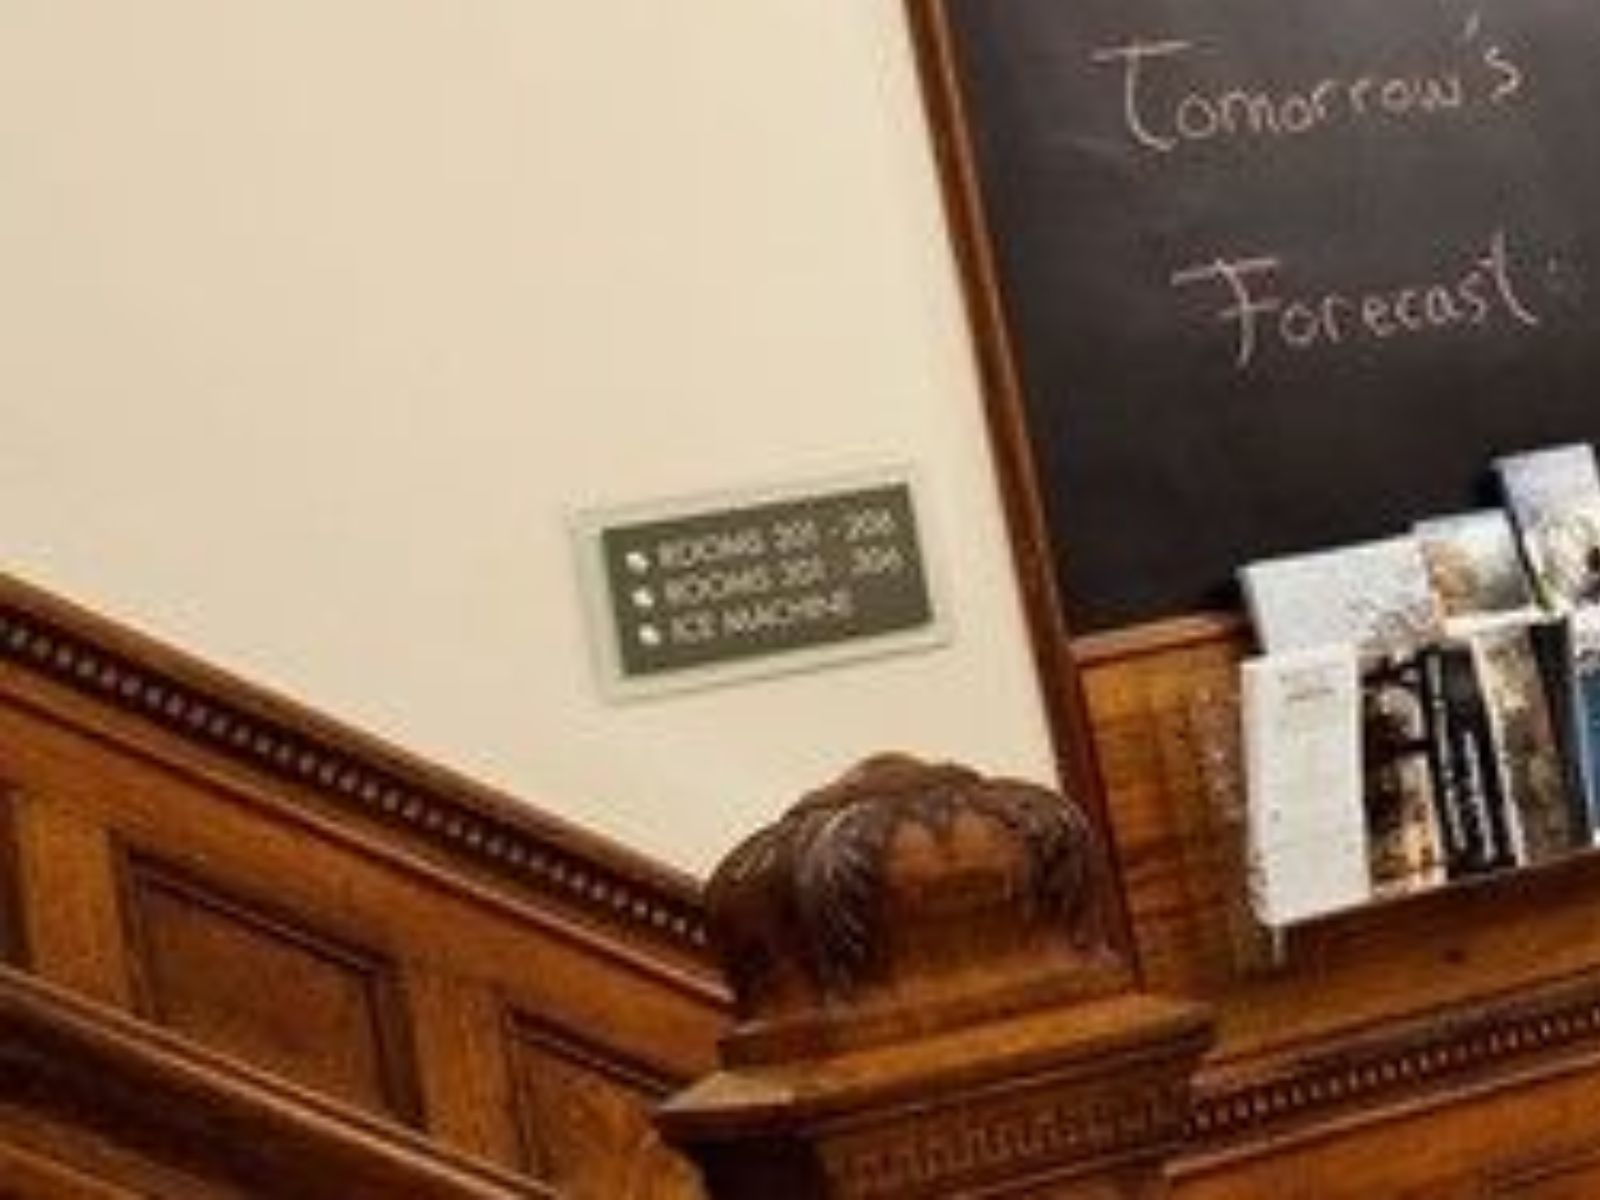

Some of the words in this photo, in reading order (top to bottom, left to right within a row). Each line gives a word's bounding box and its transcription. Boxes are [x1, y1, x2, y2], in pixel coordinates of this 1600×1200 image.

[1092, 10, 1524, 151] Tomorrow's
[656, 526, 764, 569] ROOMS
[663, 563, 772, 606] ROOMS
[670, 609, 717, 647] ICE
